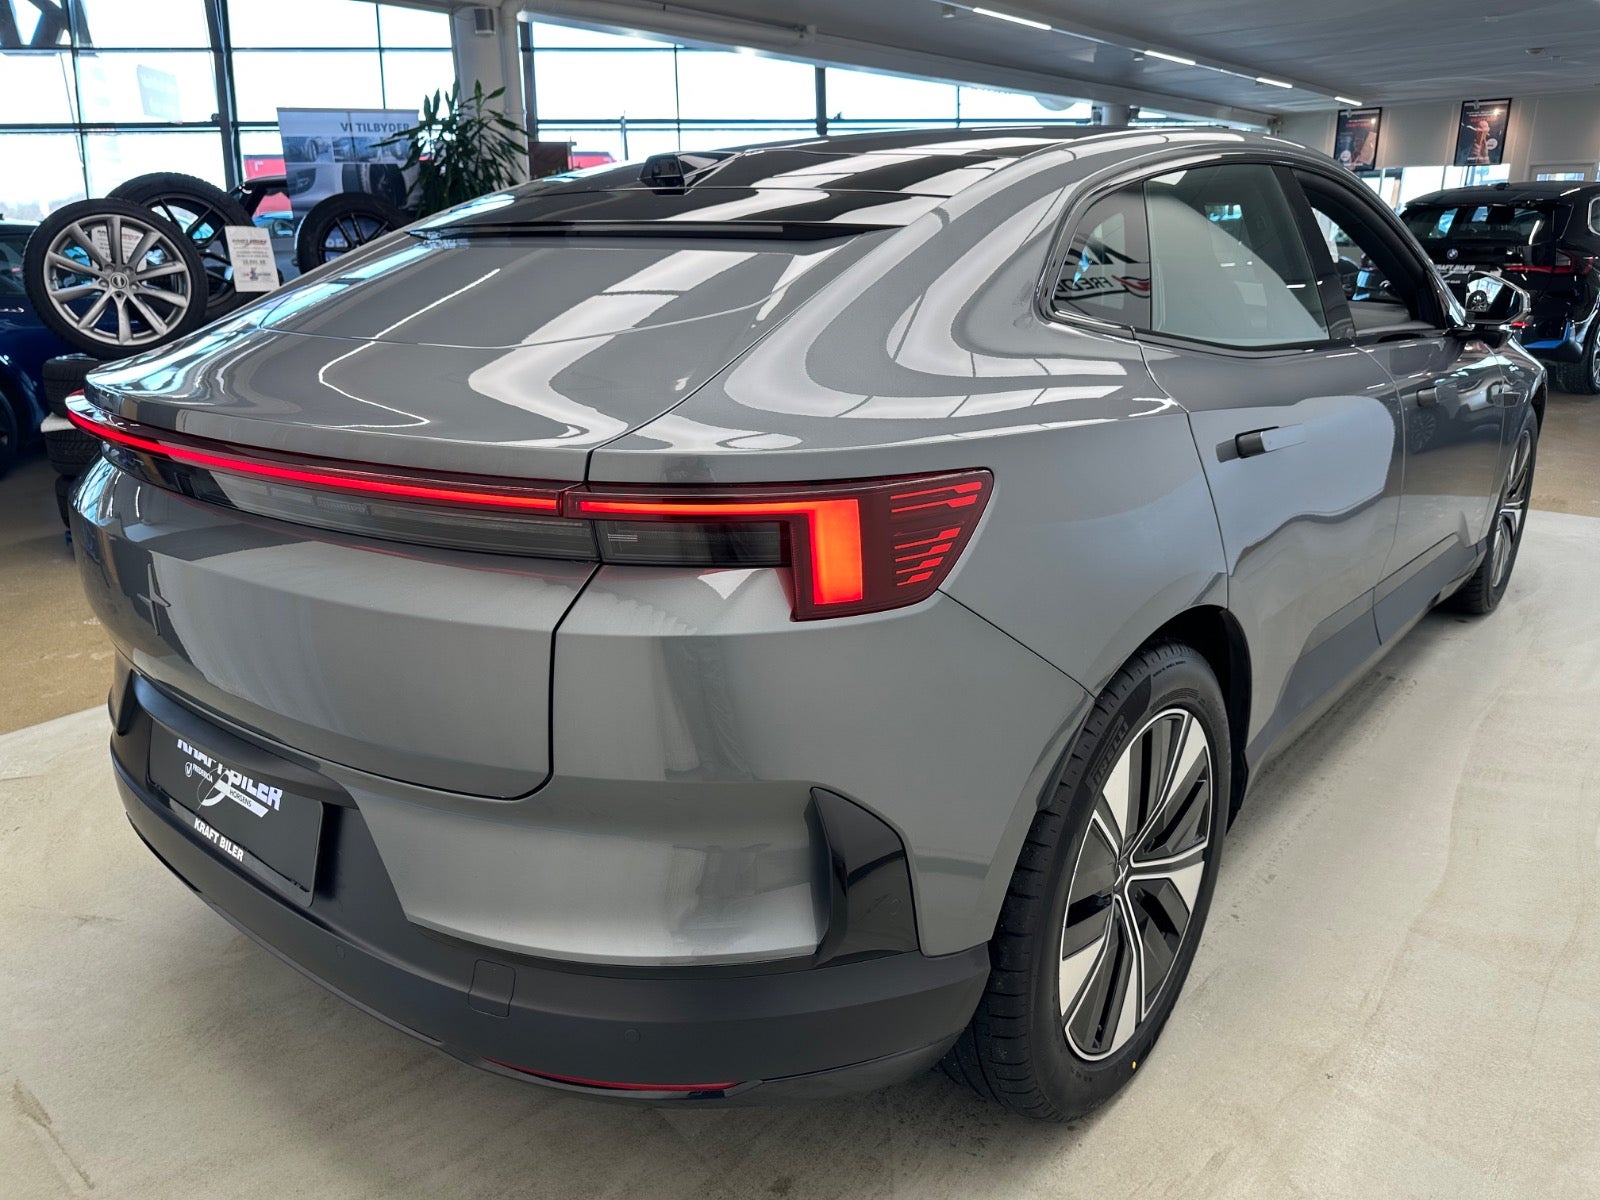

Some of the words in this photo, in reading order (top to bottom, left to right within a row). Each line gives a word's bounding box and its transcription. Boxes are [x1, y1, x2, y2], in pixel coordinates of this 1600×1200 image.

[340, 123, 353, 133] VI
[356, 123, 410, 133] TILBYDER
[230, 788, 252, 808] HORSENS
[194, 817, 220, 844] KRAFT
[219, 835, 244, 862] BILER
